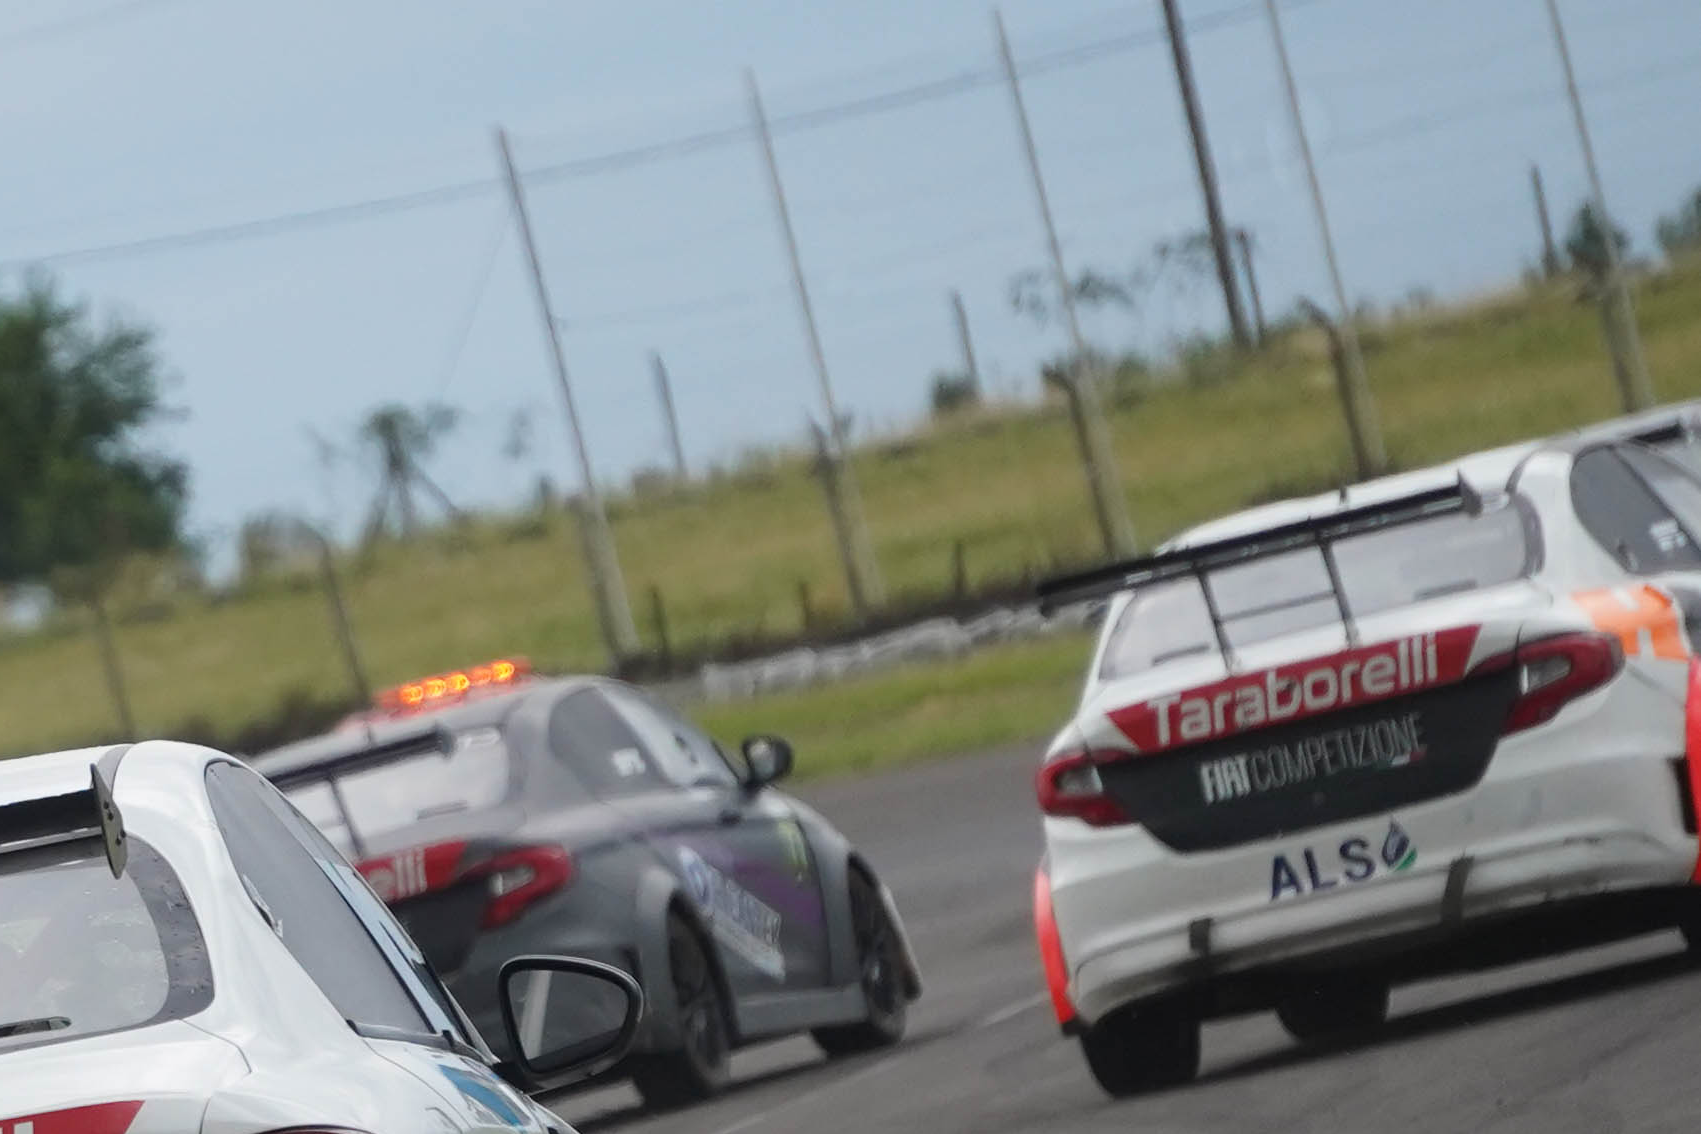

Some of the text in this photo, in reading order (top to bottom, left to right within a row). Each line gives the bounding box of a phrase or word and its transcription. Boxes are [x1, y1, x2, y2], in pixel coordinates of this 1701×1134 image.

[1147, 633, 1438, 746] Taraborelli
[1200, 754, 1251, 805] FIAT
[1270, 838, 1377, 902] ALS
